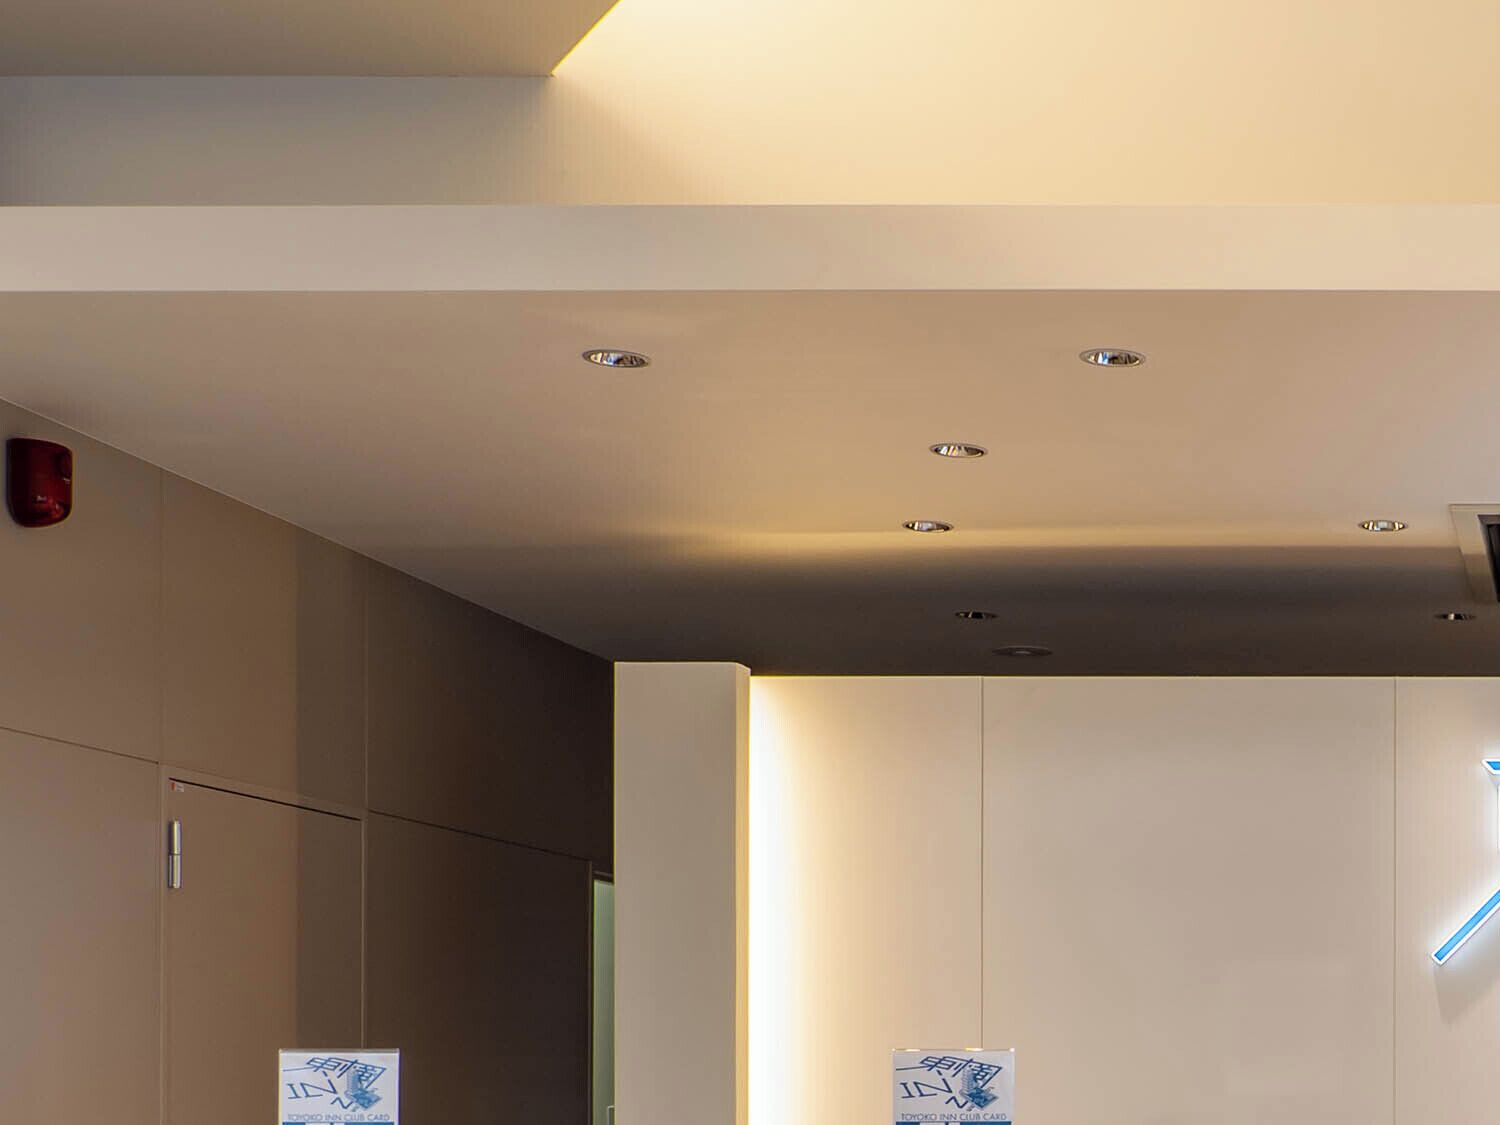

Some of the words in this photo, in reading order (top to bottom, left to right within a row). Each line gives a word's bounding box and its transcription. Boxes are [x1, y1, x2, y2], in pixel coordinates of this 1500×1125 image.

[901, 1112, 938, 1121] TOYOKO
[939, 1112, 957, 1121] INN
[959, 1112, 981, 1121] CLUB
